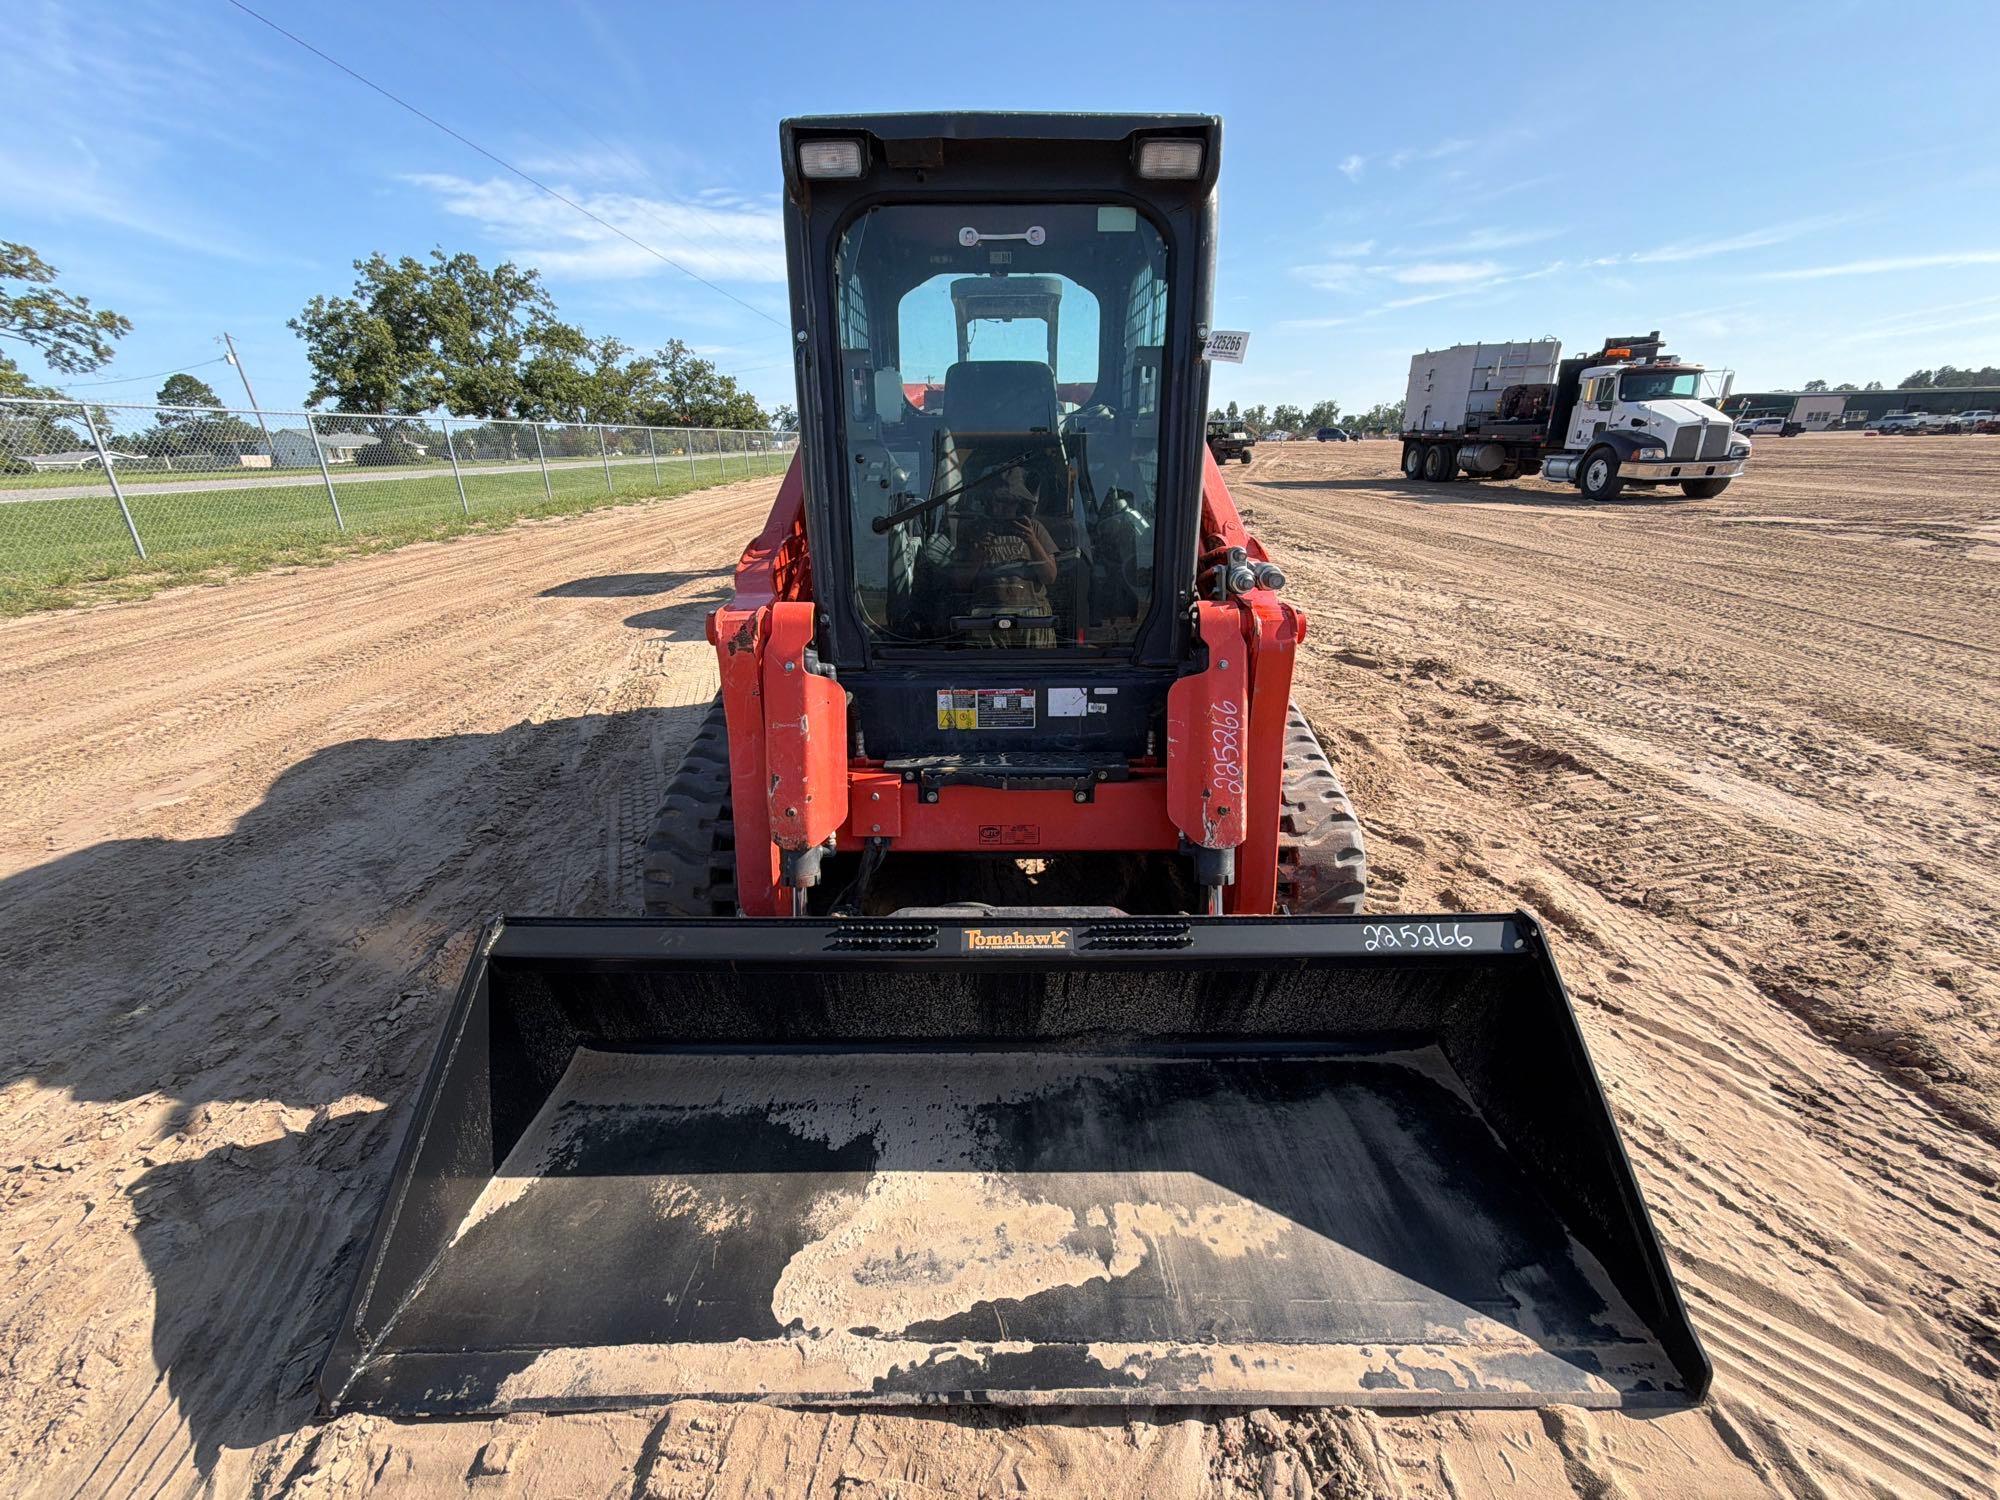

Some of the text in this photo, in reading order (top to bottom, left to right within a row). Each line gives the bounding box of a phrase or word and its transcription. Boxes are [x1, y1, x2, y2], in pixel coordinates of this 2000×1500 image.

[1212, 335, 1242, 351] 225266
[1211, 700, 1241, 794] 225266
[1363, 923, 1473, 951] 225266
